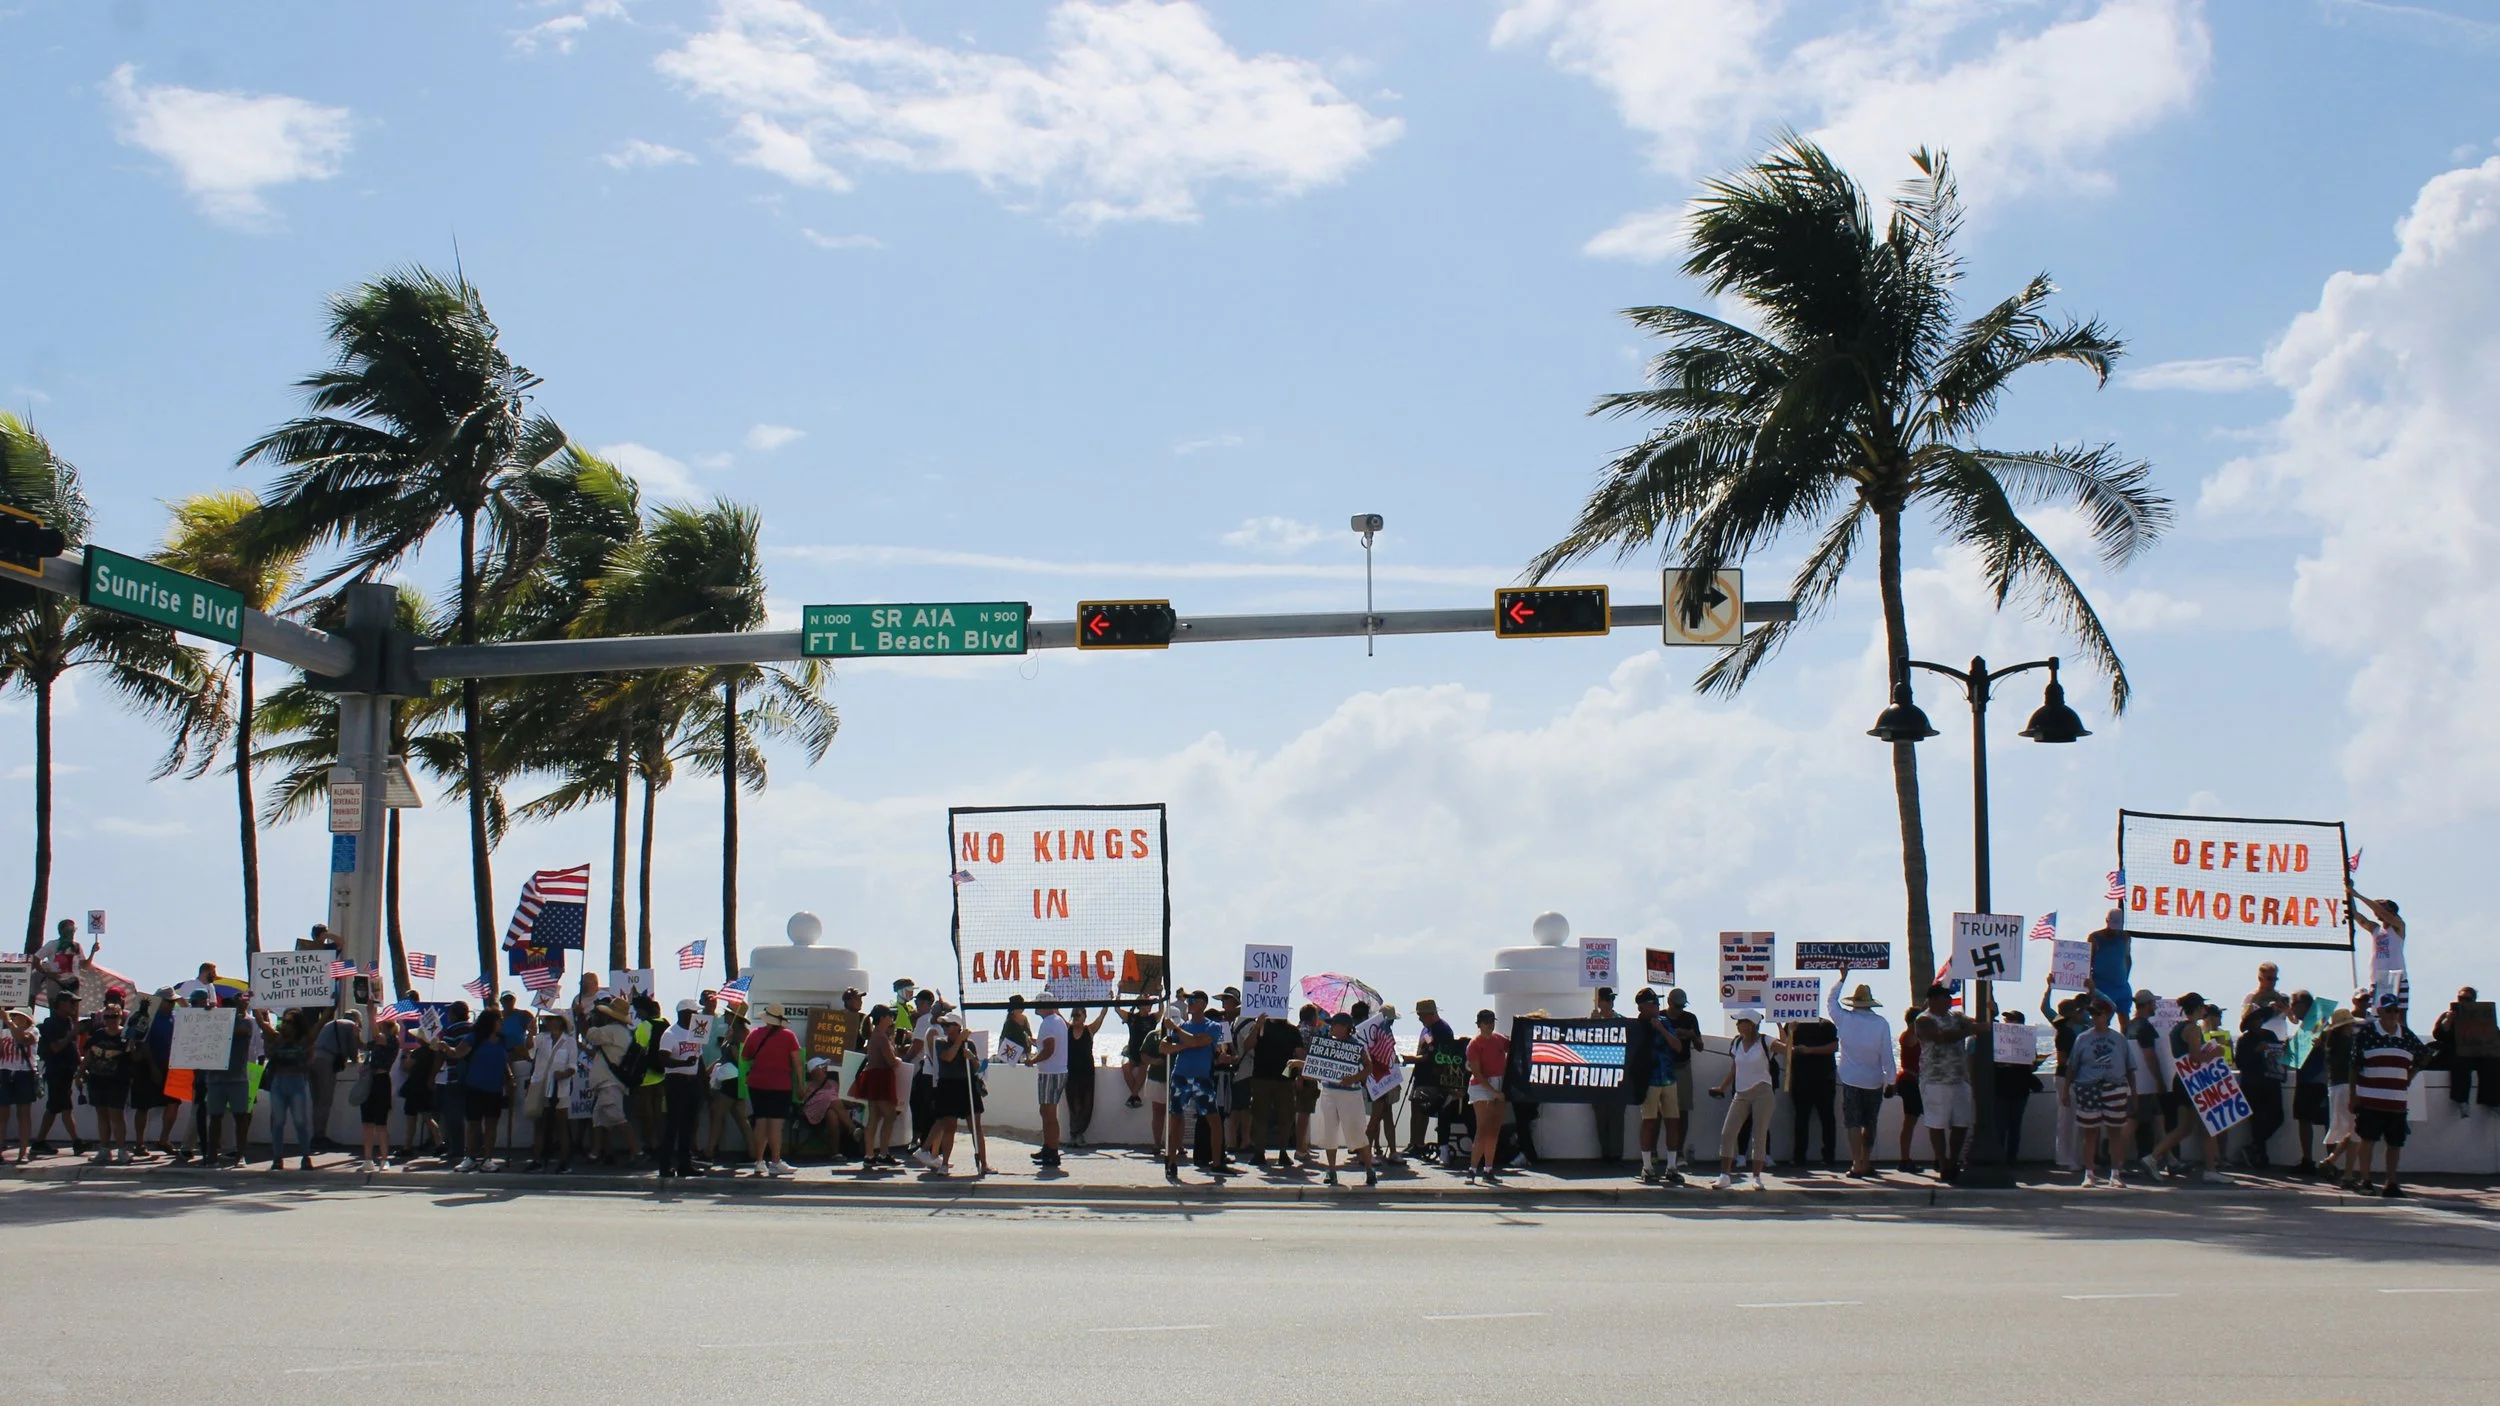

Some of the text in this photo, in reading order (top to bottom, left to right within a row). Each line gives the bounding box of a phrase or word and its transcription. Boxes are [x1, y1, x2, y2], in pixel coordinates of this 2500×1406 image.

[96, 565, 237, 629] Sunrise Blvd
[810, 614, 851, 625] N 1000
[871, 608, 956, 628] SR A1A
[980, 612, 1018, 622] N 900
[810, 630, 1018, 651] FT L Beach Blvd
[962, 828, 1149, 863] NO KINGS
[2172, 838, 2309, 873] DEFEND
[1033, 888, 1069, 919] IN
[2131, 885, 2339, 928] DEMOCRACY
[1960, 921, 2019, 937] TRUMP
[1797, 943, 1888, 954] ELECT A CLOWN
[268, 954, 321, 965] THE REAL
[973, 948, 1140, 983] AMERICA
[1253, 951, 1288, 969] STAND
[1804, 961, 1837, 969] EXPECT
[1847, 961, 1879, 969] CIRCUS
[272, 975, 325, 989] IS IN THE
[628, 975, 640, 984] NO
[1262, 971, 1278, 983] UP
[1772, 980, 1820, 988] IMPEACH
[261, 986, 329, 1000] WHITE HOUSE
[1258, 983, 1278, 994] FOR
[1247, 993, 1289, 1009] DEMOCRACY
[1775, 993, 1818, 1001] CONVICT
[827, 1013, 845, 1021] WILL
[1773, 1009, 1817, 1018] REMOVE
[833, 1024, 846, 1033] ON
[1532, 1025, 1627, 1043] PRO-AMERICA
[814, 1044, 842, 1055] GRAVE
[1311, 1036, 1363, 1054] IF THERE'S MONEY
[1309, 1045, 1361, 1063] FOR A PARADE?
[1304, 1065, 1319, 1075] FOR
[1339, 1064, 1357, 1073] MONEY
[2176, 1056, 2201, 1078] NO
[1529, 1064, 1624, 1088] ANTI-TRUMP
[2184, 1058, 2230, 1096] KINGS
[2193, 1075, 2239, 1112] SINCE
[2206, 1092, 2250, 1131] 1776
